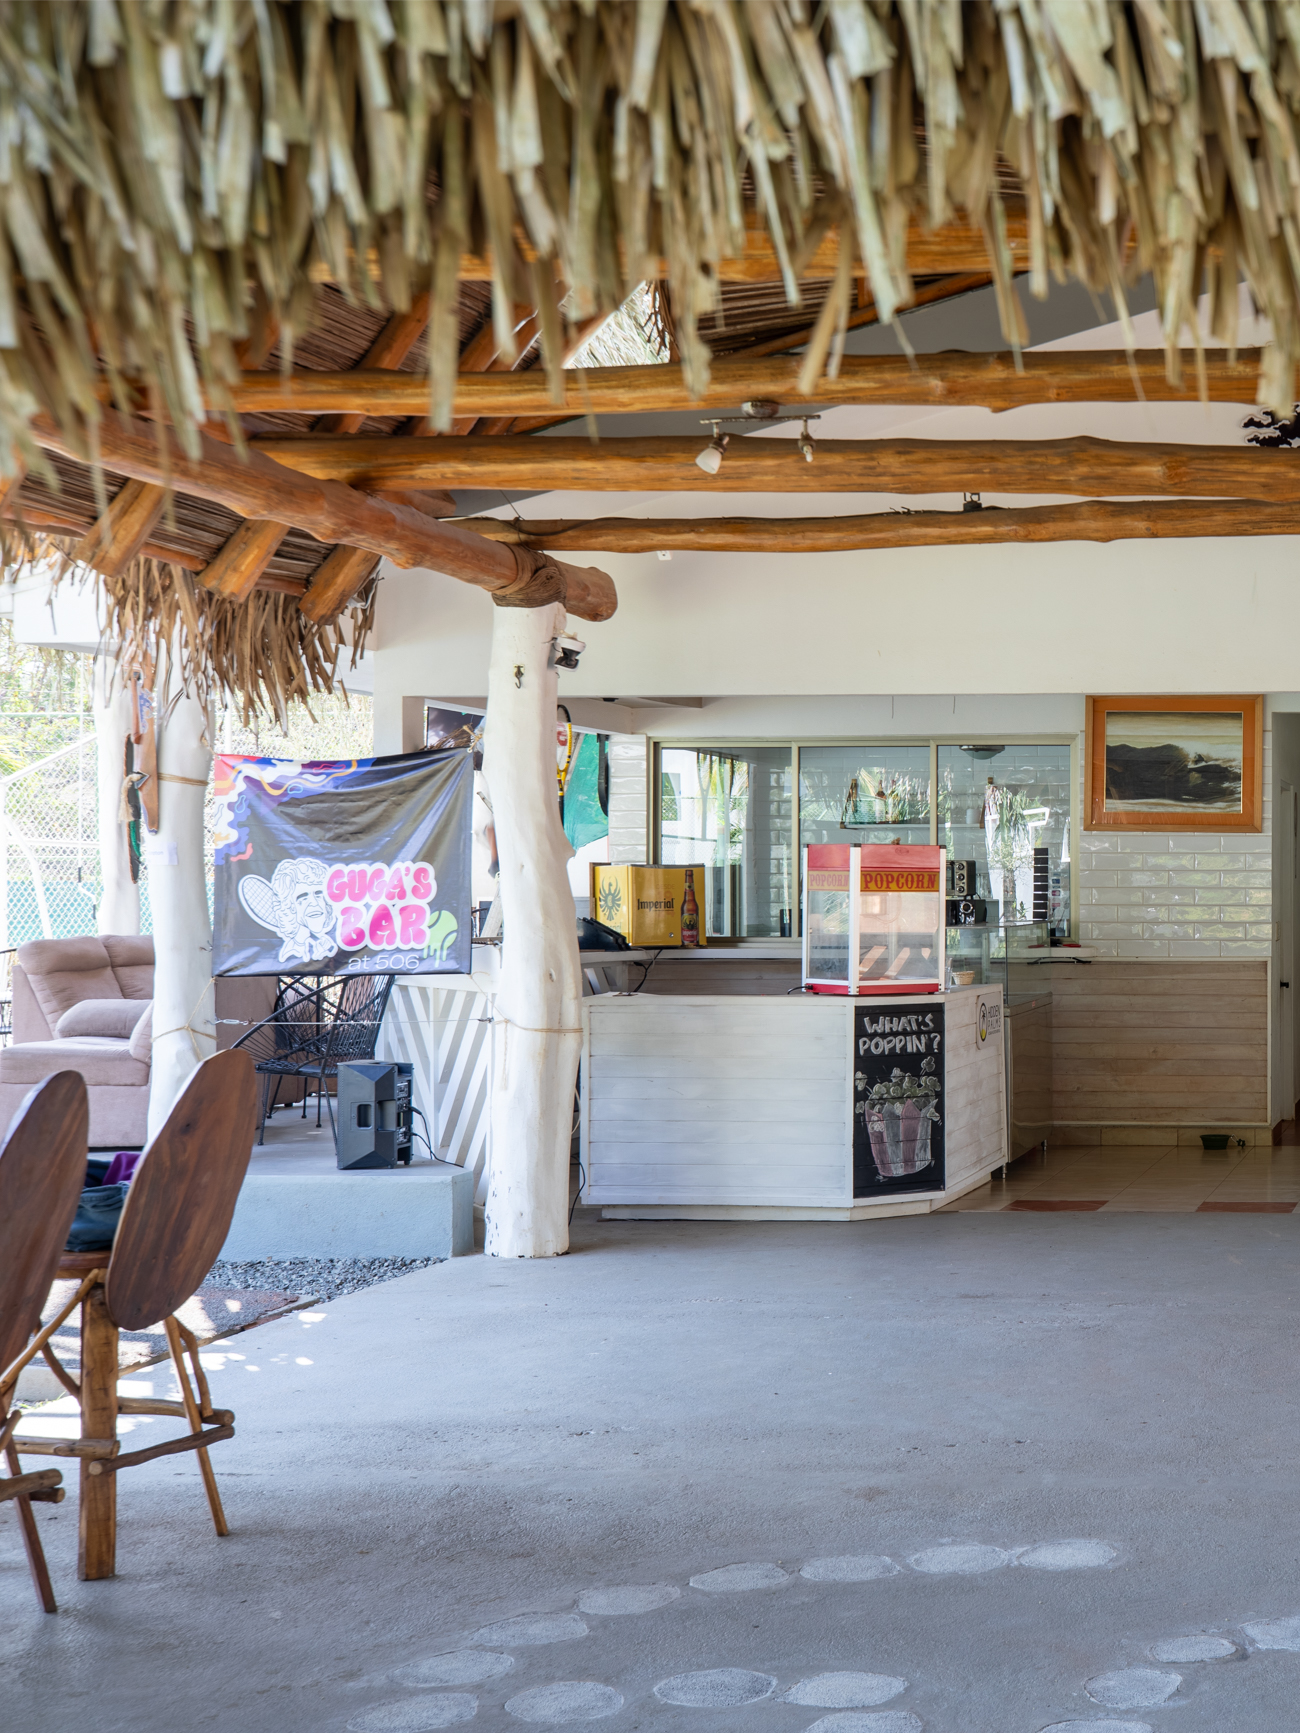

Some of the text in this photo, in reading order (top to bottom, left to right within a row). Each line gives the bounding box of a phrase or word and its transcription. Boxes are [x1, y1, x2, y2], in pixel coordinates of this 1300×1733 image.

[326, 866, 432, 902] GUGA'S
[809, 873, 849, 887] POPCORN
[862, 873, 938, 889] POPCORN
[637, 898, 674, 912] Imperial
[340, 904, 427, 947] BAR
[348, 954, 420, 970] at 506
[864, 1013, 934, 1034] WHAT'S
